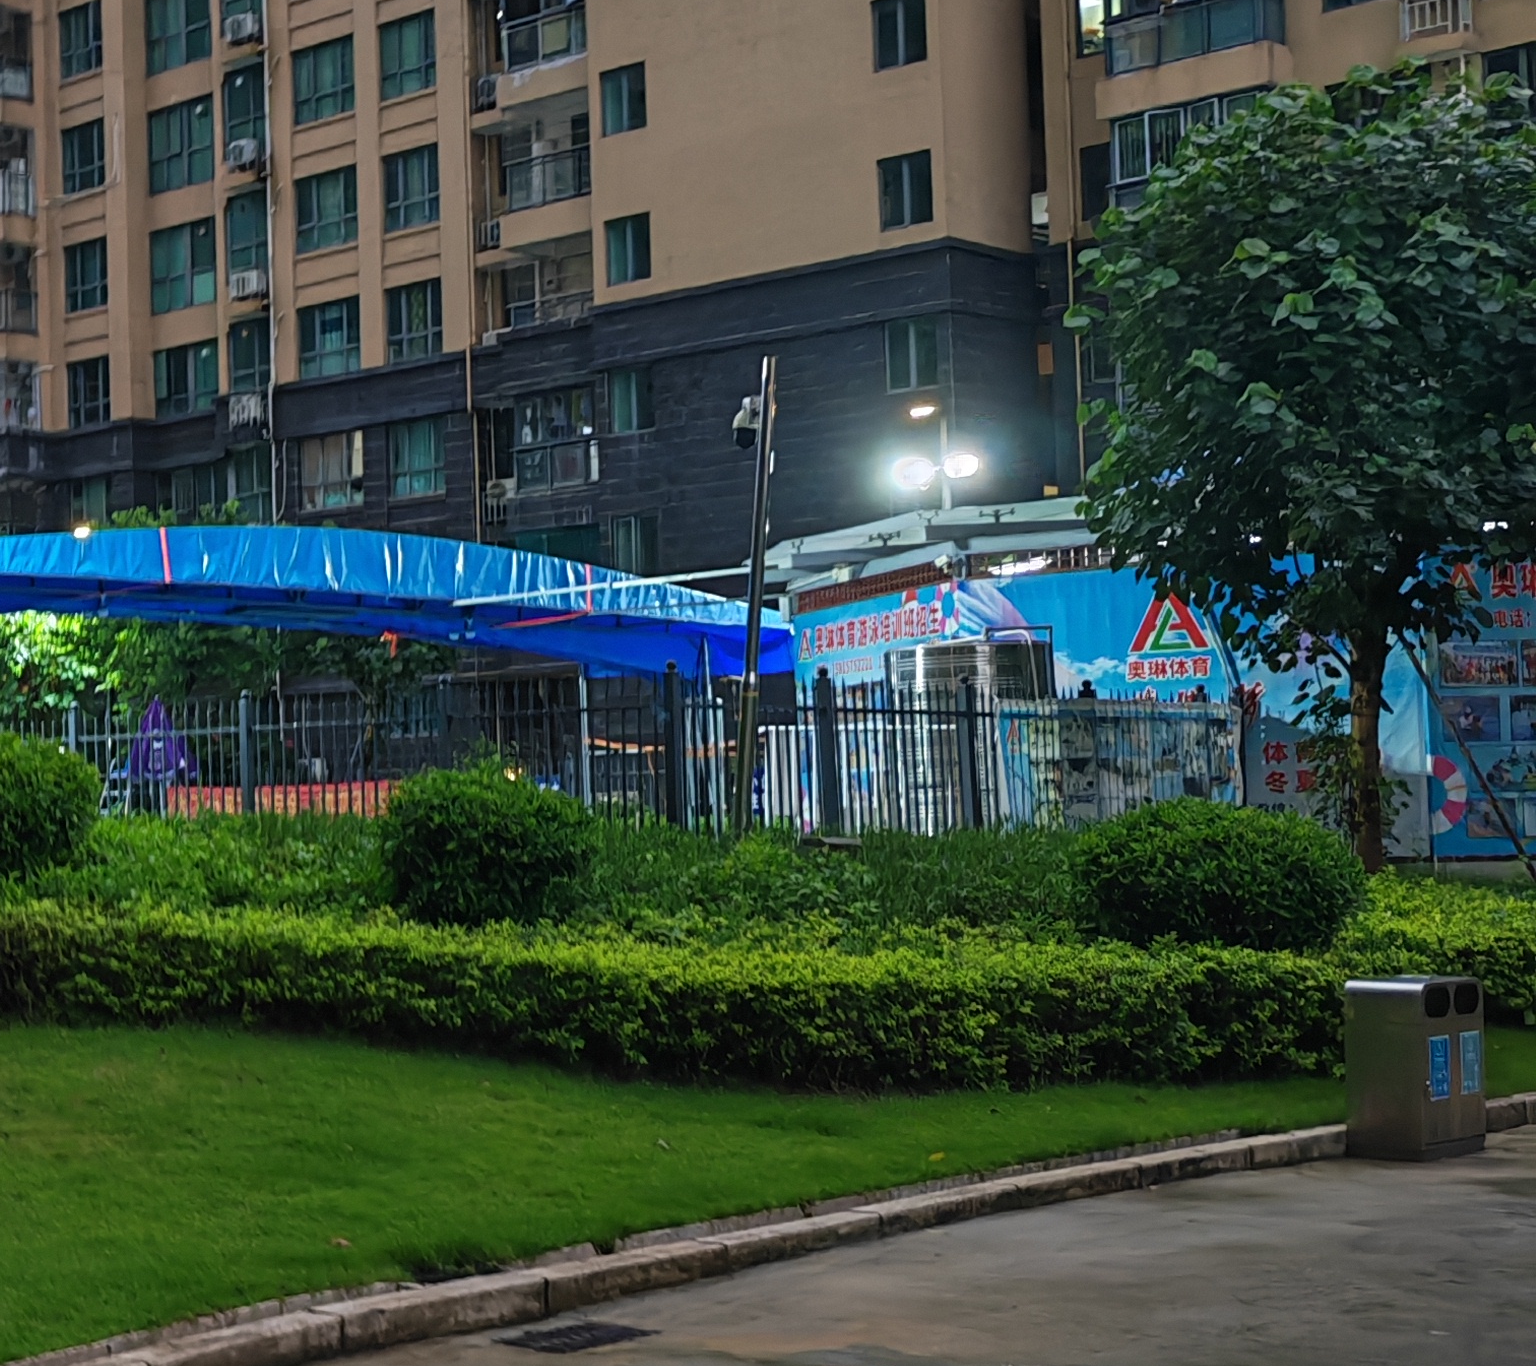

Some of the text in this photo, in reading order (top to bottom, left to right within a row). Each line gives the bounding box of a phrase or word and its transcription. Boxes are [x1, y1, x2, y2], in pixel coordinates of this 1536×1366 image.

[815, 603, 940, 654] 奥琳体育游泳培训班招生
[1128, 657, 1210, 680] 奥琳体育
